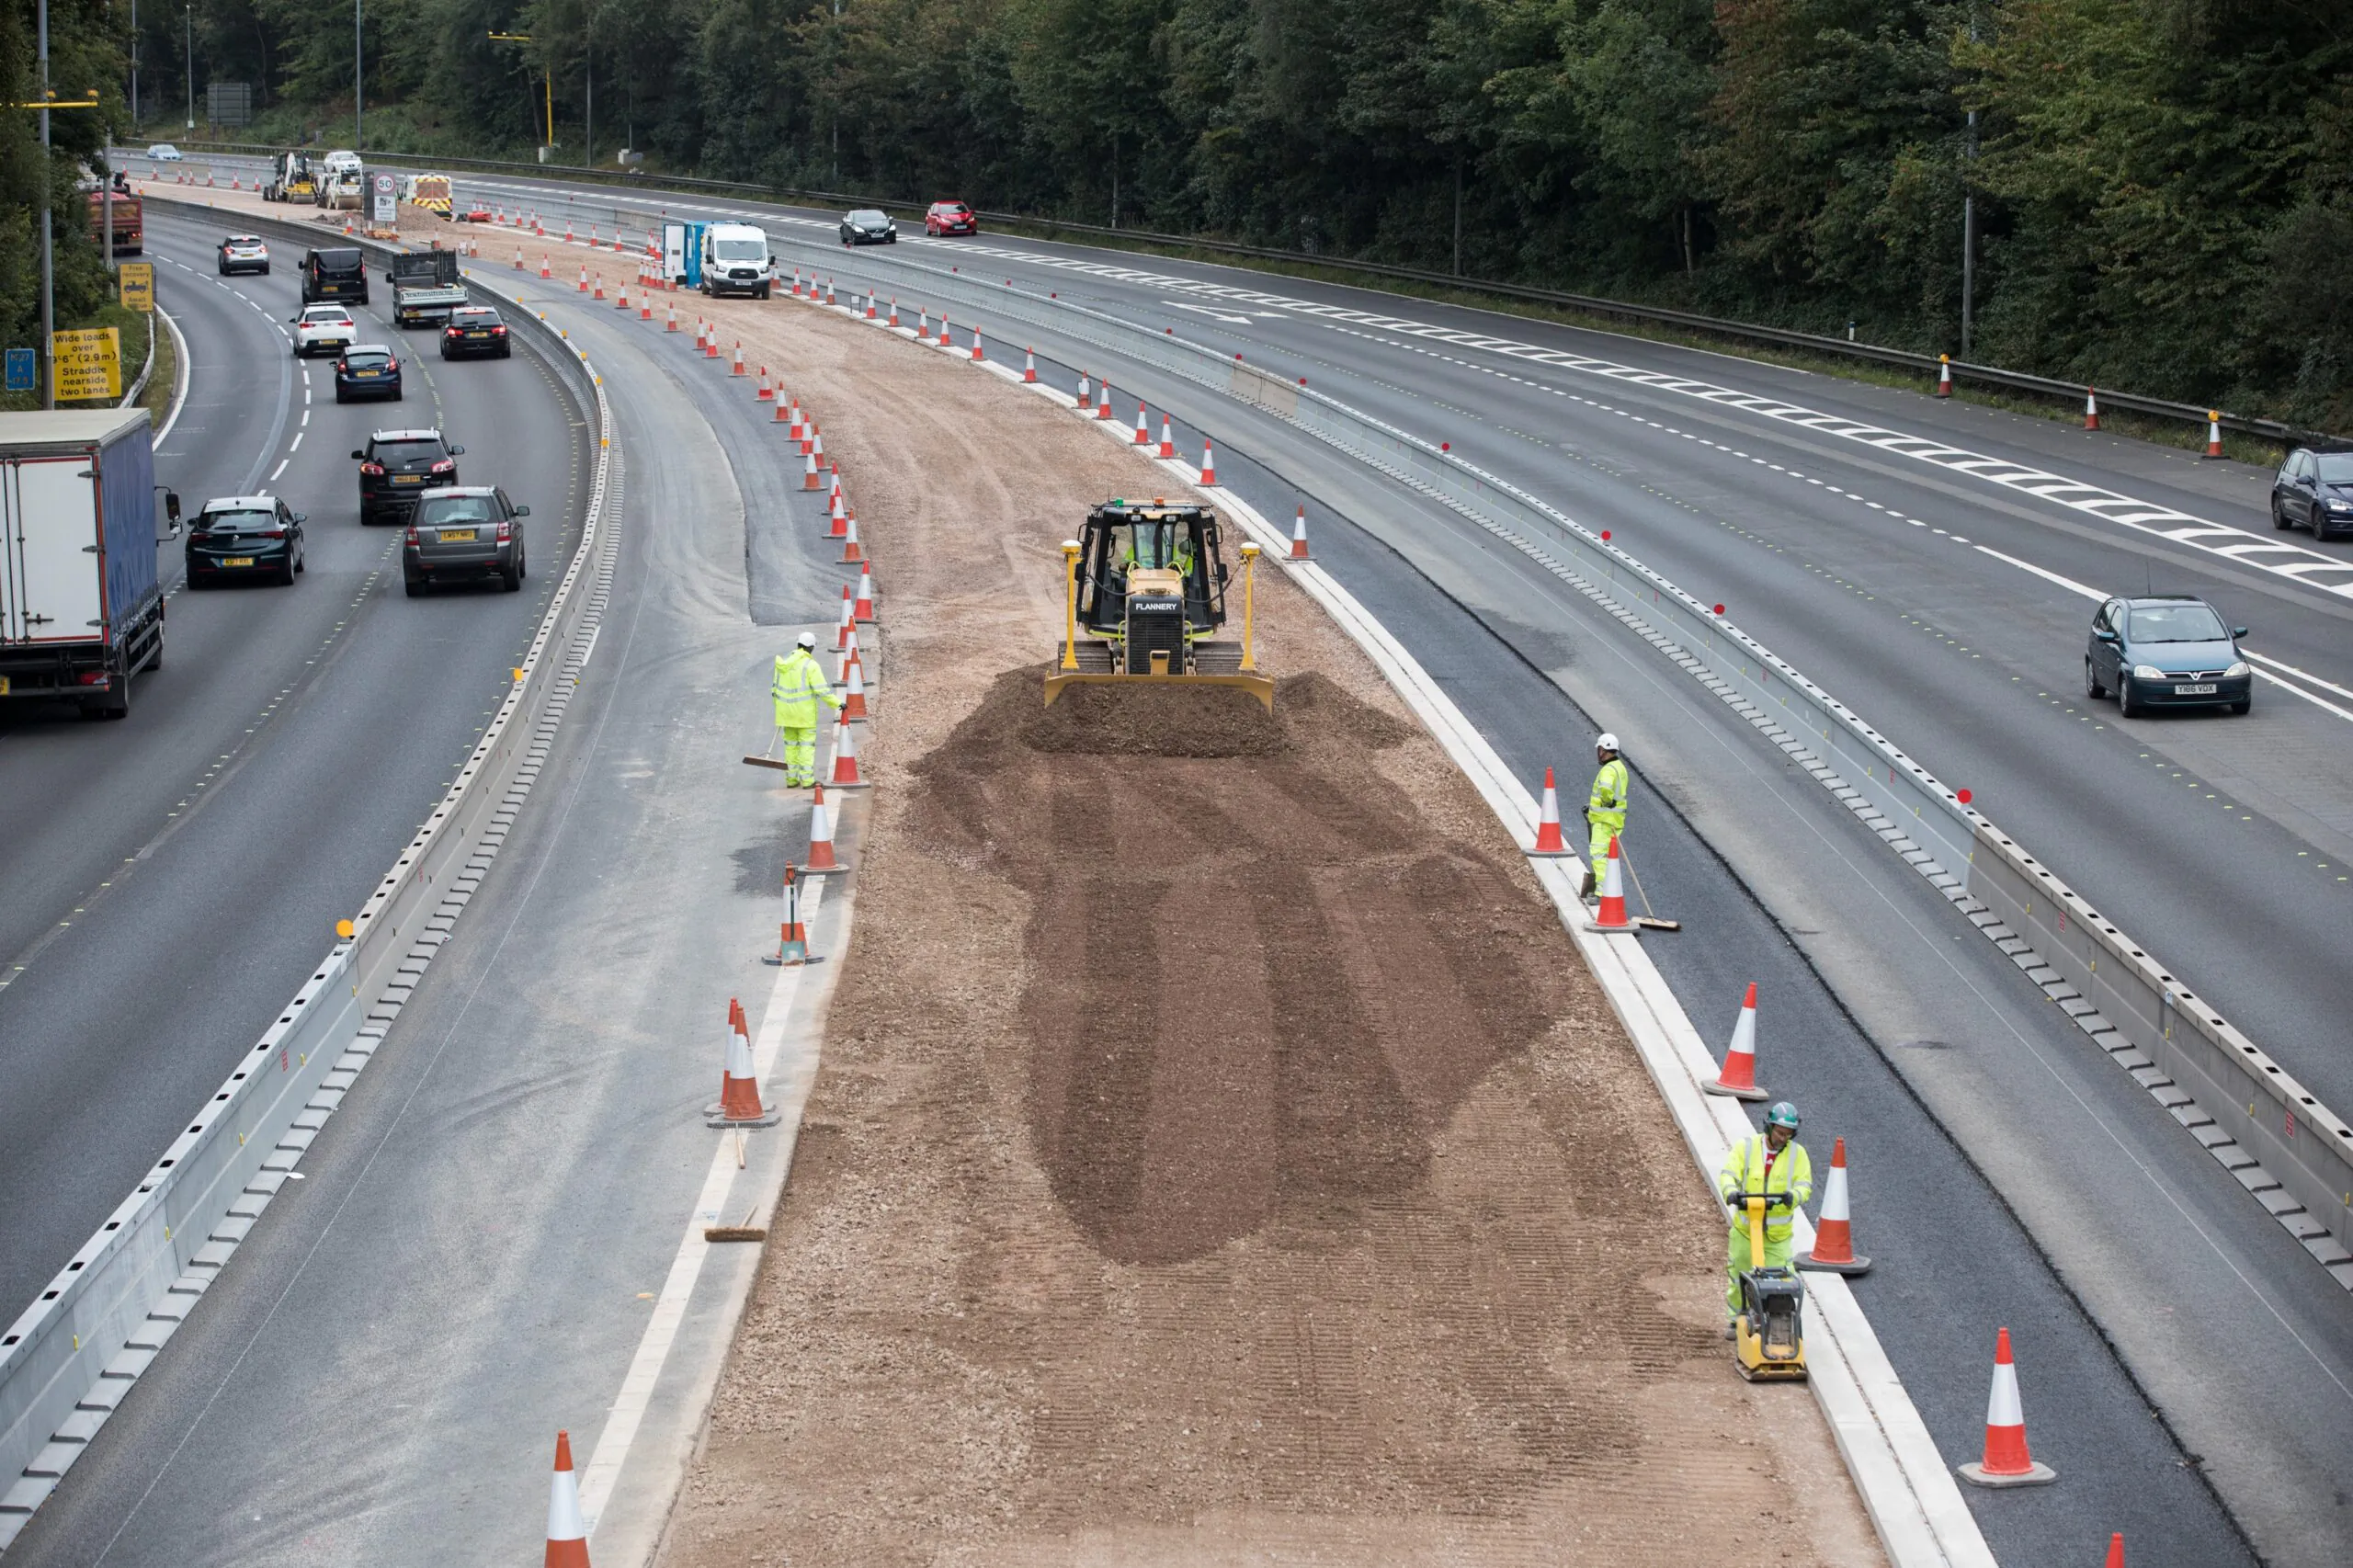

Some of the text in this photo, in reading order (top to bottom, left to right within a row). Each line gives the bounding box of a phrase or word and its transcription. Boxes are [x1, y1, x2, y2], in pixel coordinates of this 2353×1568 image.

[379, 179, 392, 187] 50
[55, 332, 110, 343] Wide loads
[63, 367, 107, 376] Straddle
[61, 386, 110, 396] two lanes
